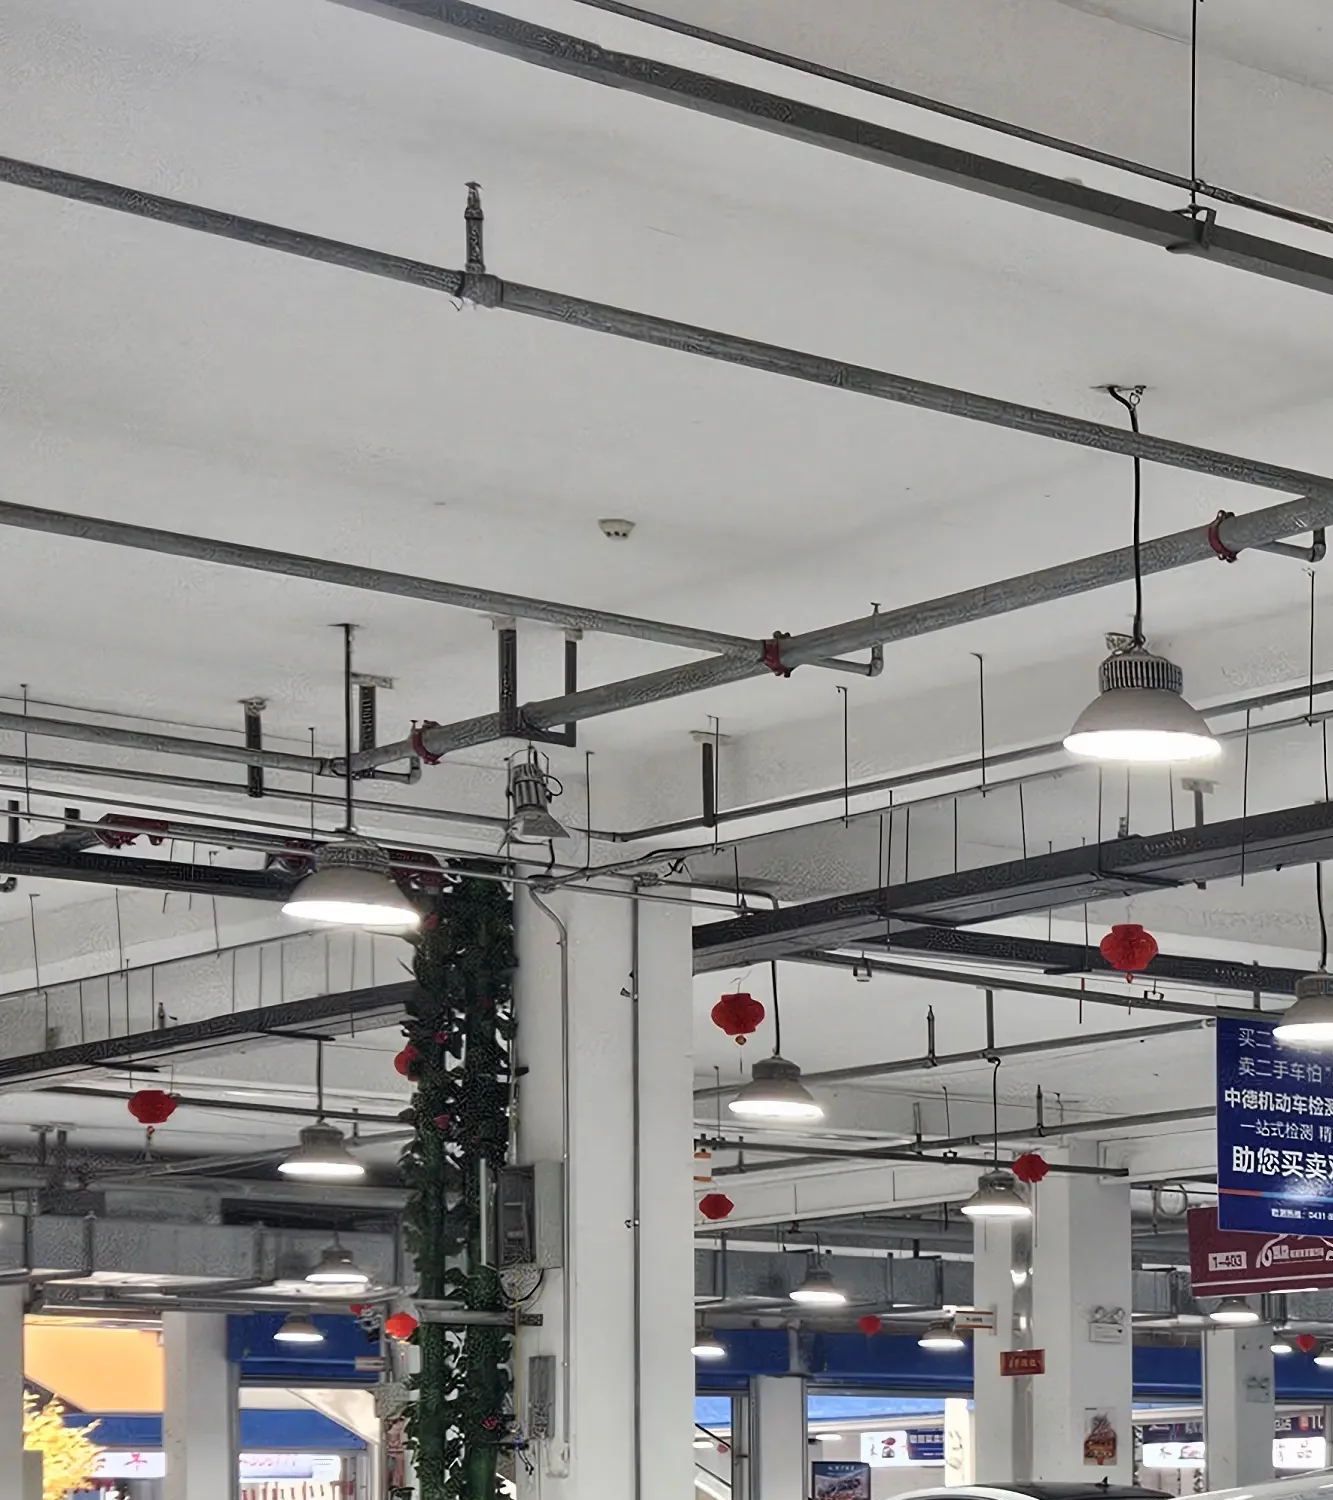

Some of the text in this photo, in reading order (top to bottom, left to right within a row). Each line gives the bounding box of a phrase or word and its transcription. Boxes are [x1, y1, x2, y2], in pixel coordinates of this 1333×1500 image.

[1240, 1119, 1314, 1142] 一站式检测
